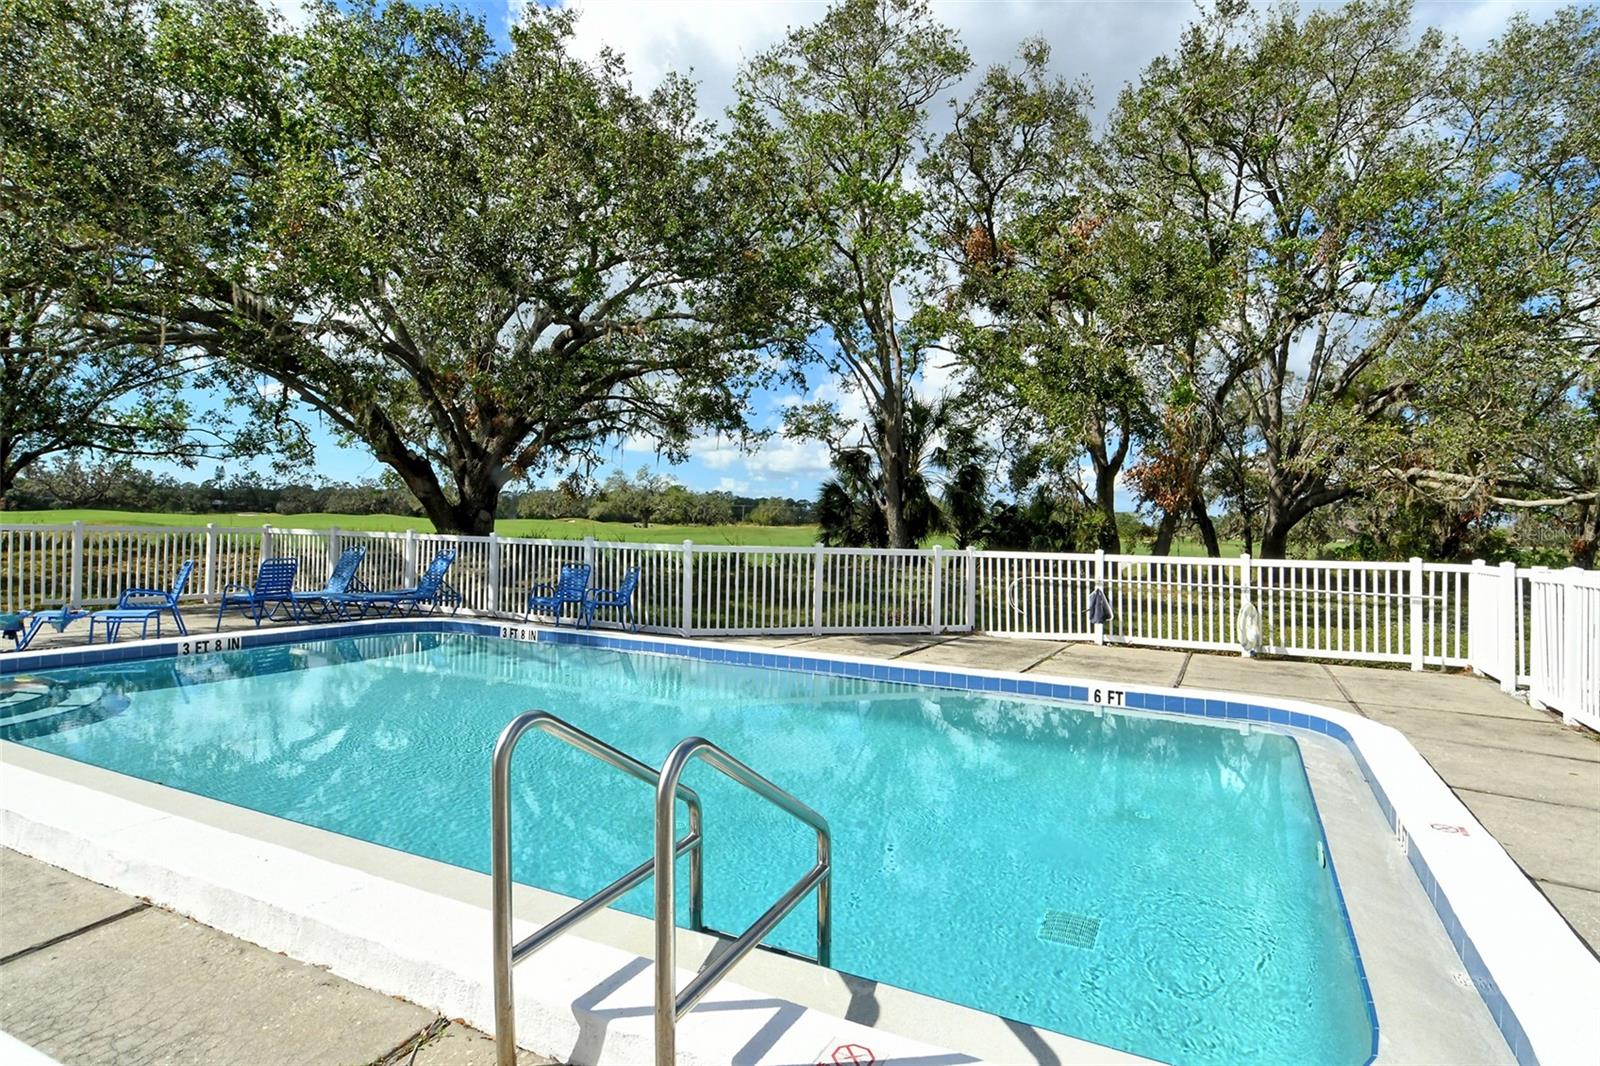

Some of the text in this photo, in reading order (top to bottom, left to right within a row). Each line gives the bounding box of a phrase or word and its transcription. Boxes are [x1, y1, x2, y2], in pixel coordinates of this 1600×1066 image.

[502, 627, 537, 641] 3 FT 8 IN
[182, 637, 240, 655] 3 FT 8 IN
[1093, 688, 1124, 706] 6 FT
